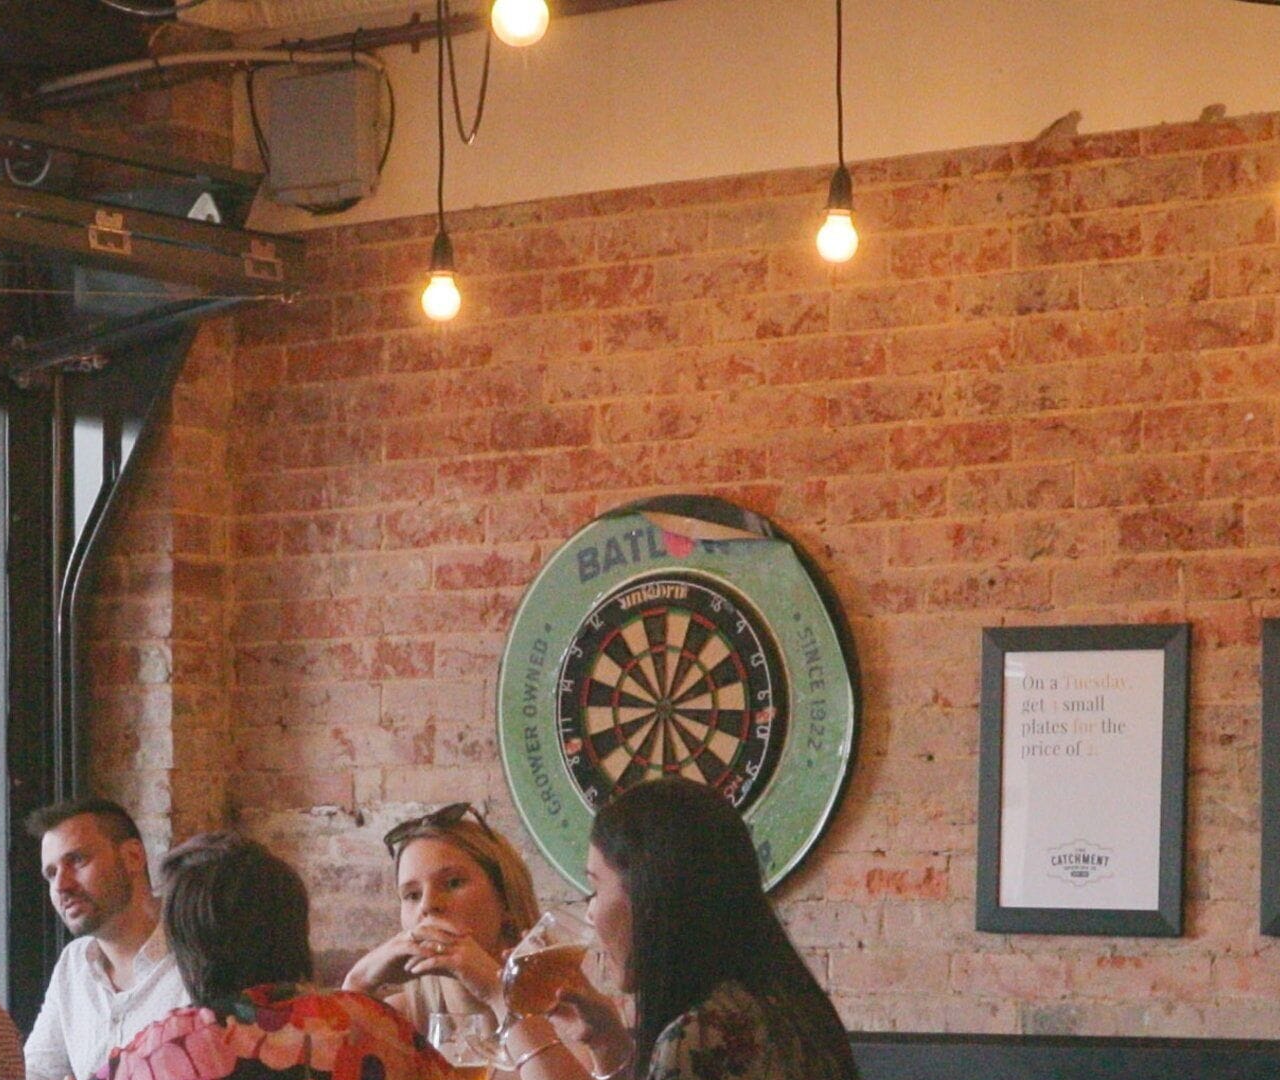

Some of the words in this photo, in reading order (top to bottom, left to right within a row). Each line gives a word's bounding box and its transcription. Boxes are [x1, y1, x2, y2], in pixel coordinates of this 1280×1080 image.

[797, 627, 826, 692] SINCE
[523, 637, 548, 718] OWNED
[1022, 675, 1045, 690] On
[1049, 679, 1058, 690] a
[1022, 698, 1044, 714] get
[1062, 695, 1105, 712] small
[807, 699, 827, 751] 1922
[1021, 718, 1068, 738] plates
[1102, 718, 1127, 734] the
[1021, 741, 1061, 760] price
[1065, 740, 1082, 757] of
[525, 725, 562, 816] GROWER
[1051, 853, 1110, 867] CATCHMENT
